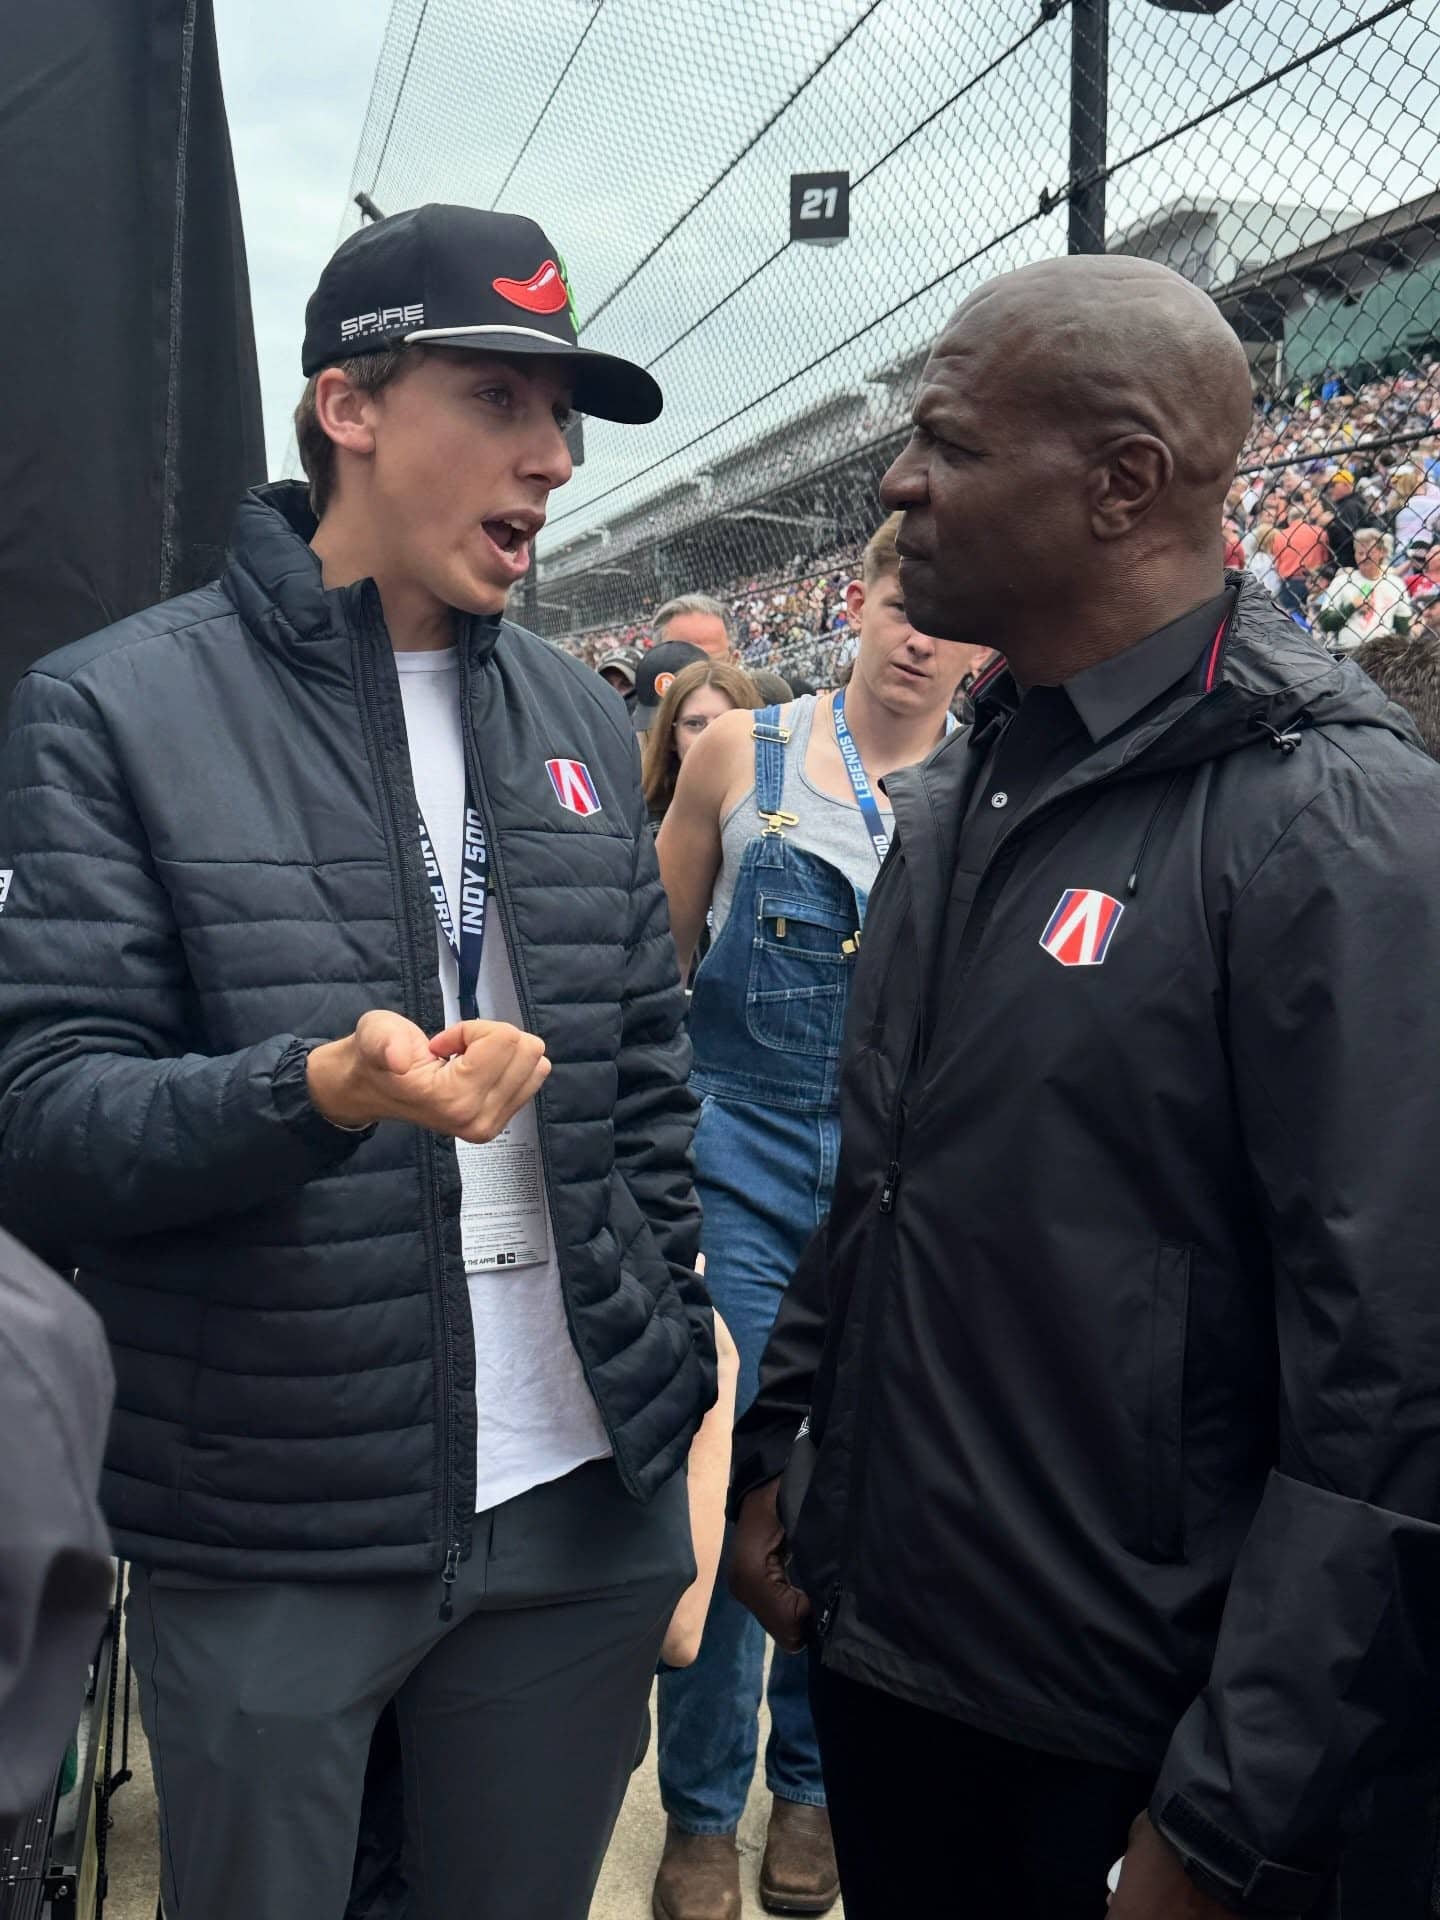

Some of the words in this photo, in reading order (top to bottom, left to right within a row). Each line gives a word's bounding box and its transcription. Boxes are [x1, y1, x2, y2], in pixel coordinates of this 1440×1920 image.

[800, 187, 838, 219] 21
[341, 303, 424, 337] SPIRE
[834, 708, 847, 733] DAY
[839, 735, 872, 799] LEGENDS
[465, 807, 486, 863] 500
[430, 885, 456, 946] PRIX
[462, 867, 485, 935] INDY
